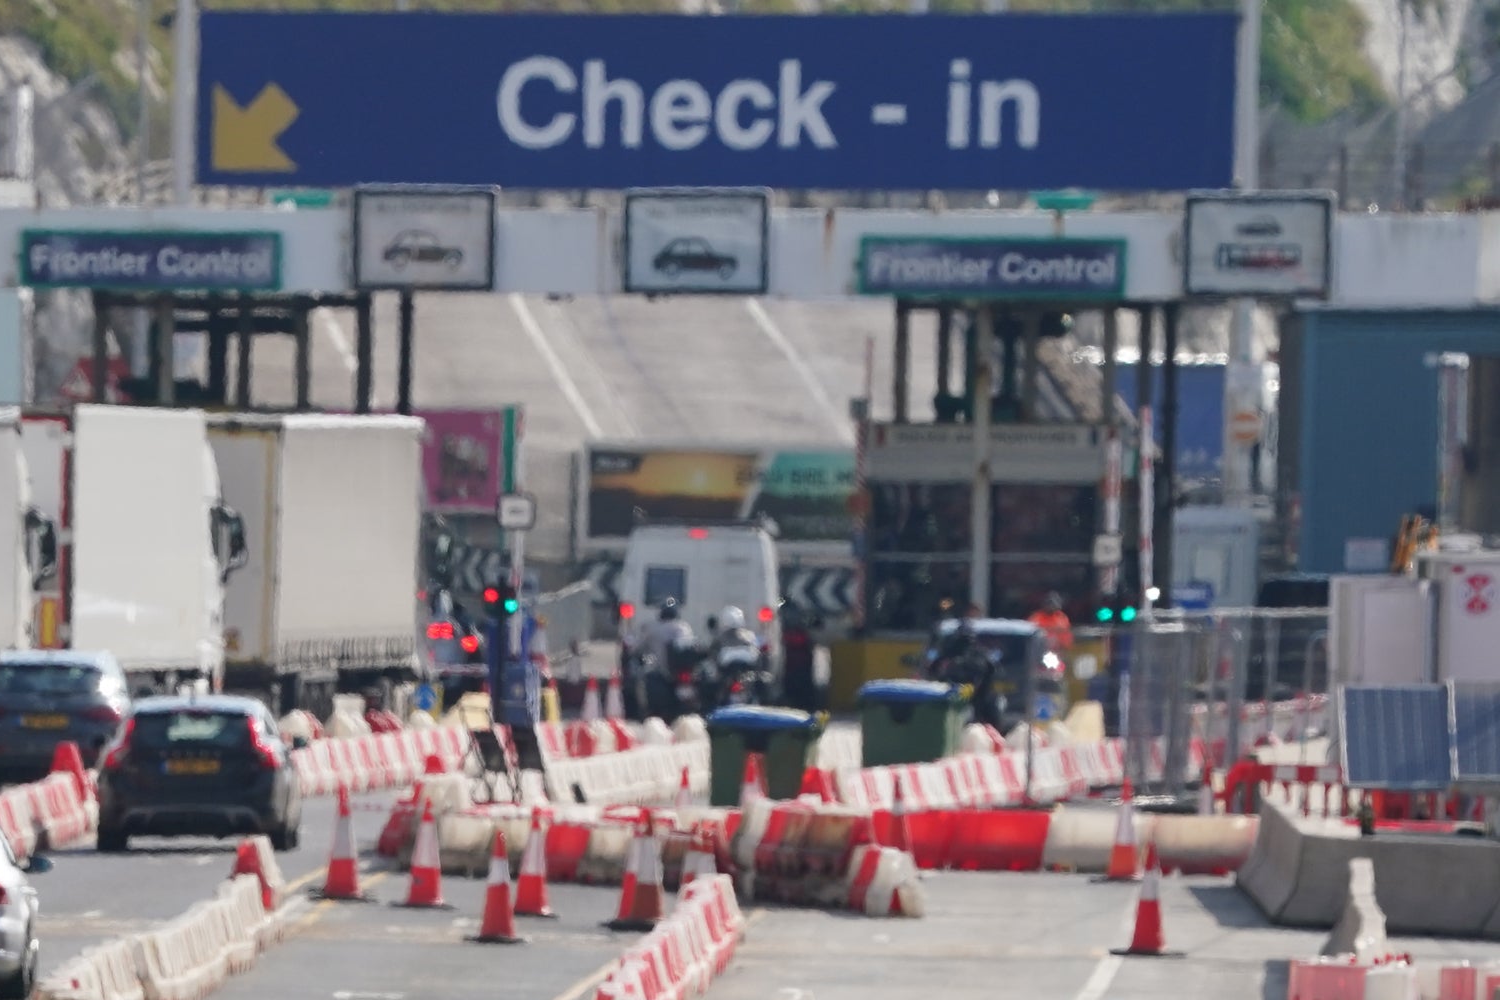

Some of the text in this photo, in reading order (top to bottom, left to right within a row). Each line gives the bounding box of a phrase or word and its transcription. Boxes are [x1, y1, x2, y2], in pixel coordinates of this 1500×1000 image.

[497, 55, 1040, 150] Check - in
[30, 243, 272, 278] Frontier Control
[868, 250, 1116, 285] Frontier Control
